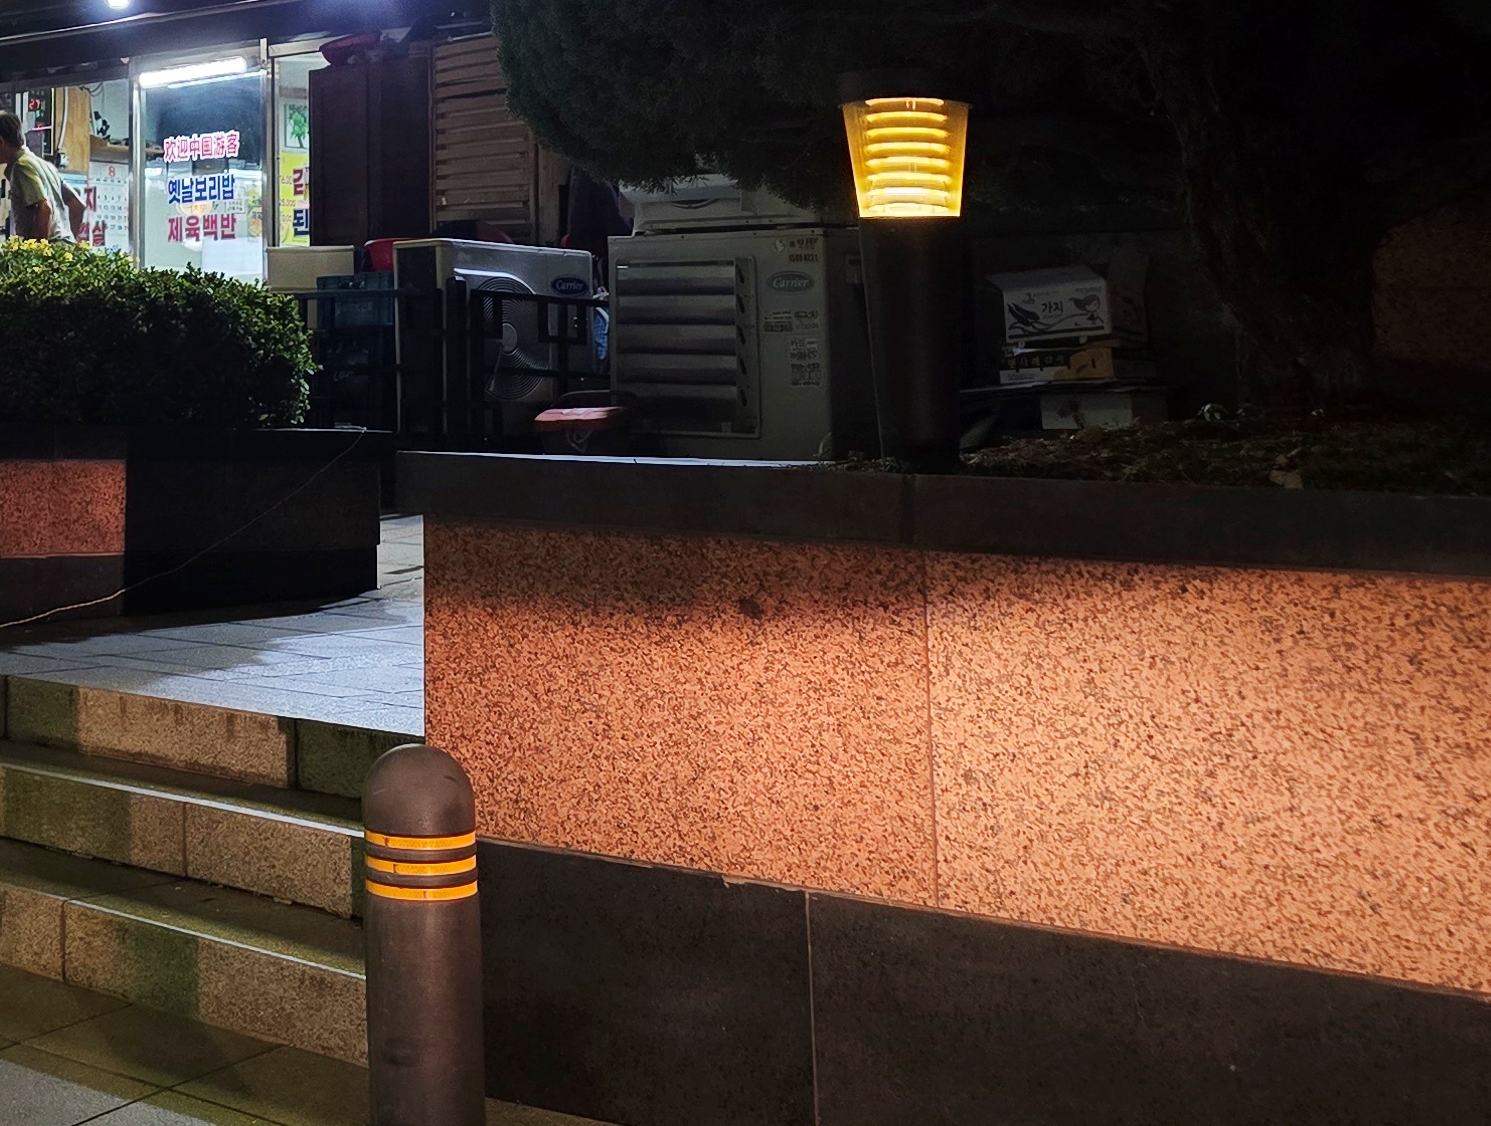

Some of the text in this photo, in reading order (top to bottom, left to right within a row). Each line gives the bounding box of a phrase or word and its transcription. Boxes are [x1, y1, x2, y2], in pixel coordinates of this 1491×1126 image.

[165, 132, 239, 161] 欢迎中国游客
[168, 174, 236, 205] 옛날보리밥
[168, 214, 237, 242] 제육백반
[772, 276, 810, 289] Carrier
[1041, 300, 1064, 314] 가지
